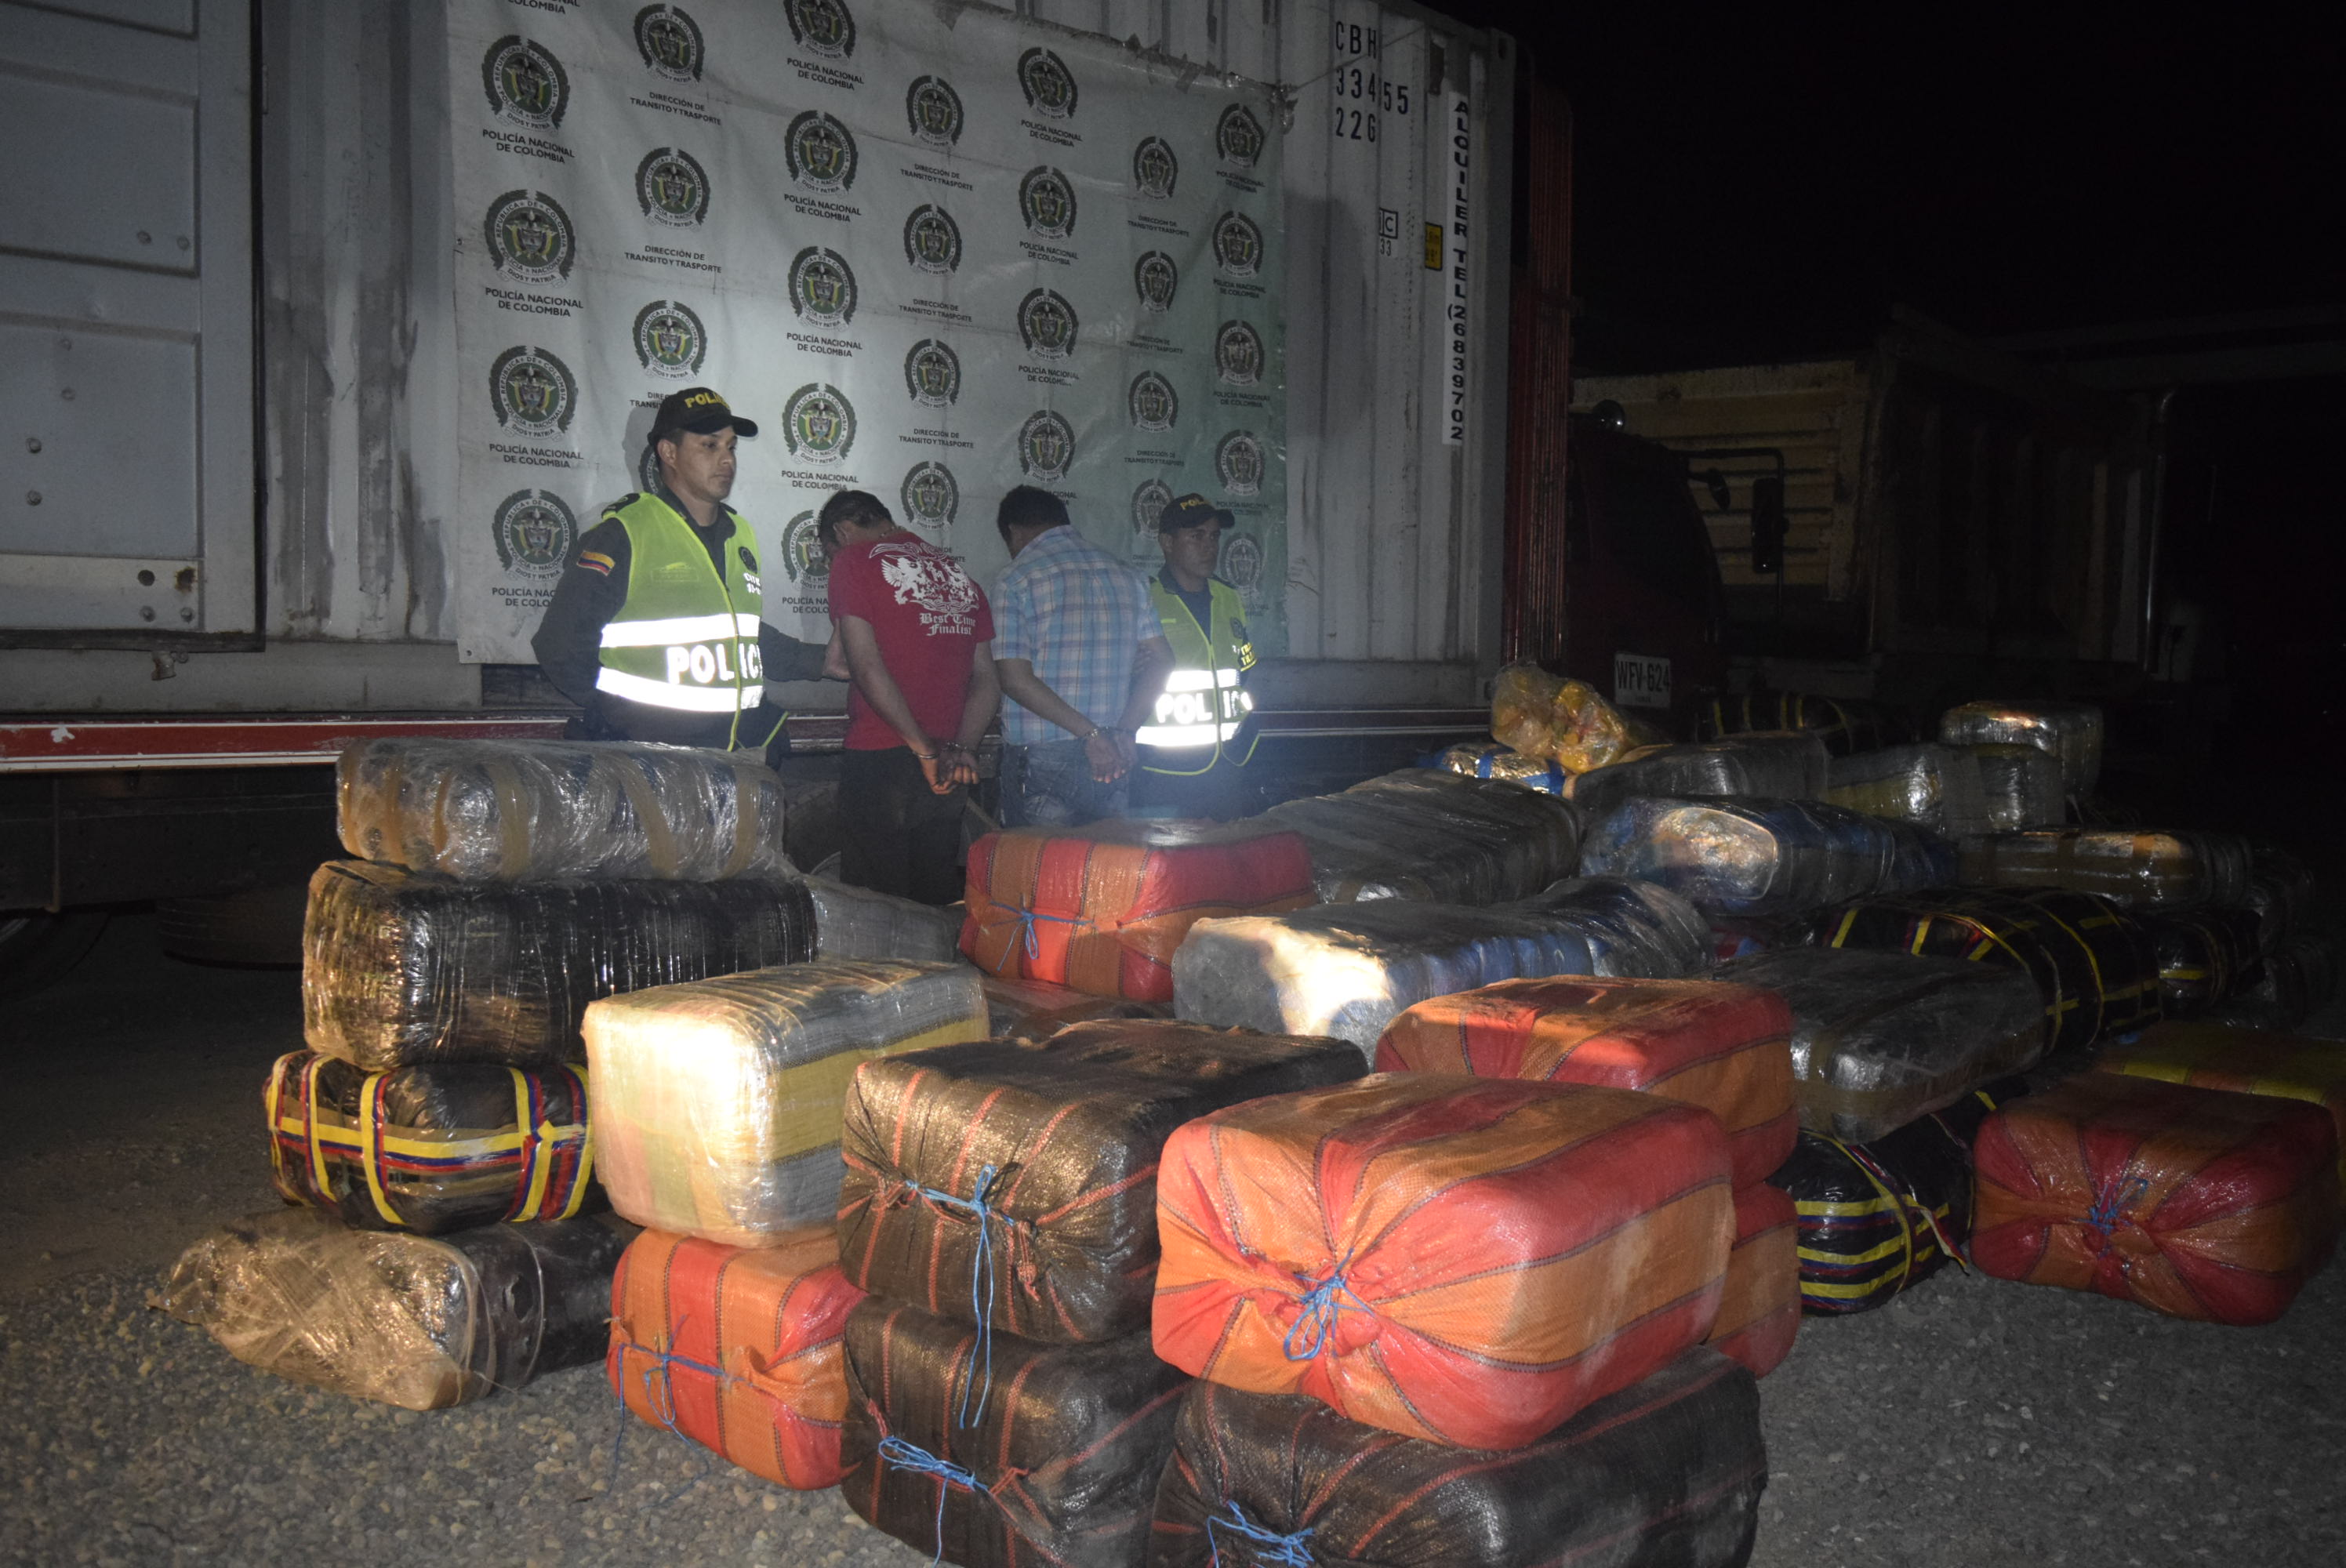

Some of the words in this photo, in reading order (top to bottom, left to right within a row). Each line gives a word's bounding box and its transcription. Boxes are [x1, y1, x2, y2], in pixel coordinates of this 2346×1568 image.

[1336, 21, 1376, 59] CBH
[787, 57, 820, 72] POLICÍA
[822, 66, 864, 85] NACIONAL
[797, 69, 809, 78] DE
[812, 72, 855, 91] COLOMBIA
[630, 97, 672, 113] TRANSITO
[680, 109, 721, 126] TRASPORTE
[695, 103, 705, 111] DE
[1336, 107, 1375, 143] 22G
[483, 129, 526, 144] POLICÍA
[528, 137, 576, 158] NACIONAL
[496, 142, 510, 151] DE
[514, 146, 565, 164] COLOMBIA
[1454, 101, 1469, 238] ALQUILER
[784, 194, 816, 207] POLICÍA
[819, 201, 862, 216] NACIONAL
[795, 205, 806, 213] DE
[808, 207, 850, 222] COLOMBIA
[1046, 247, 1079, 260] NACIONAL
[1380, 238, 1391, 256] 33
[625, 252, 669, 265] TRANSITO
[676, 259, 722, 274] TRASPORTE
[694, 252, 705, 261] DE
[1037, 253, 1070, 265] COLOMBIA
[485, 287, 525, 301] POLICÍA
[528, 294, 583, 309] NACIONAL
[498, 300, 510, 310] DE
[514, 302, 571, 317] COLOMBIA
[786, 332, 819, 344] POLICÍA
[821, 338, 862, 350] NACIONAL
[811, 345, 852, 358] COLOMBIA
[489, 443, 528, 454] POLICÍA
[531, 448, 584, 460] NACIONAL
[504, 455, 517, 464] DE
[520, 456, 571, 469] COLOMBIA
[781, 470, 814, 480] POLICÍA
[815, 474, 859, 483] NACIONAL
[492, 587, 532, 597] POLICÍA
[783, 596, 814, 605] POLICÍA
[506, 598, 517, 608] DE
[520, 598, 550, 608] COLO
[920, 612, 948, 626] Best
[953, 613, 975, 626] Time
[926, 623, 971, 636] Finalist
